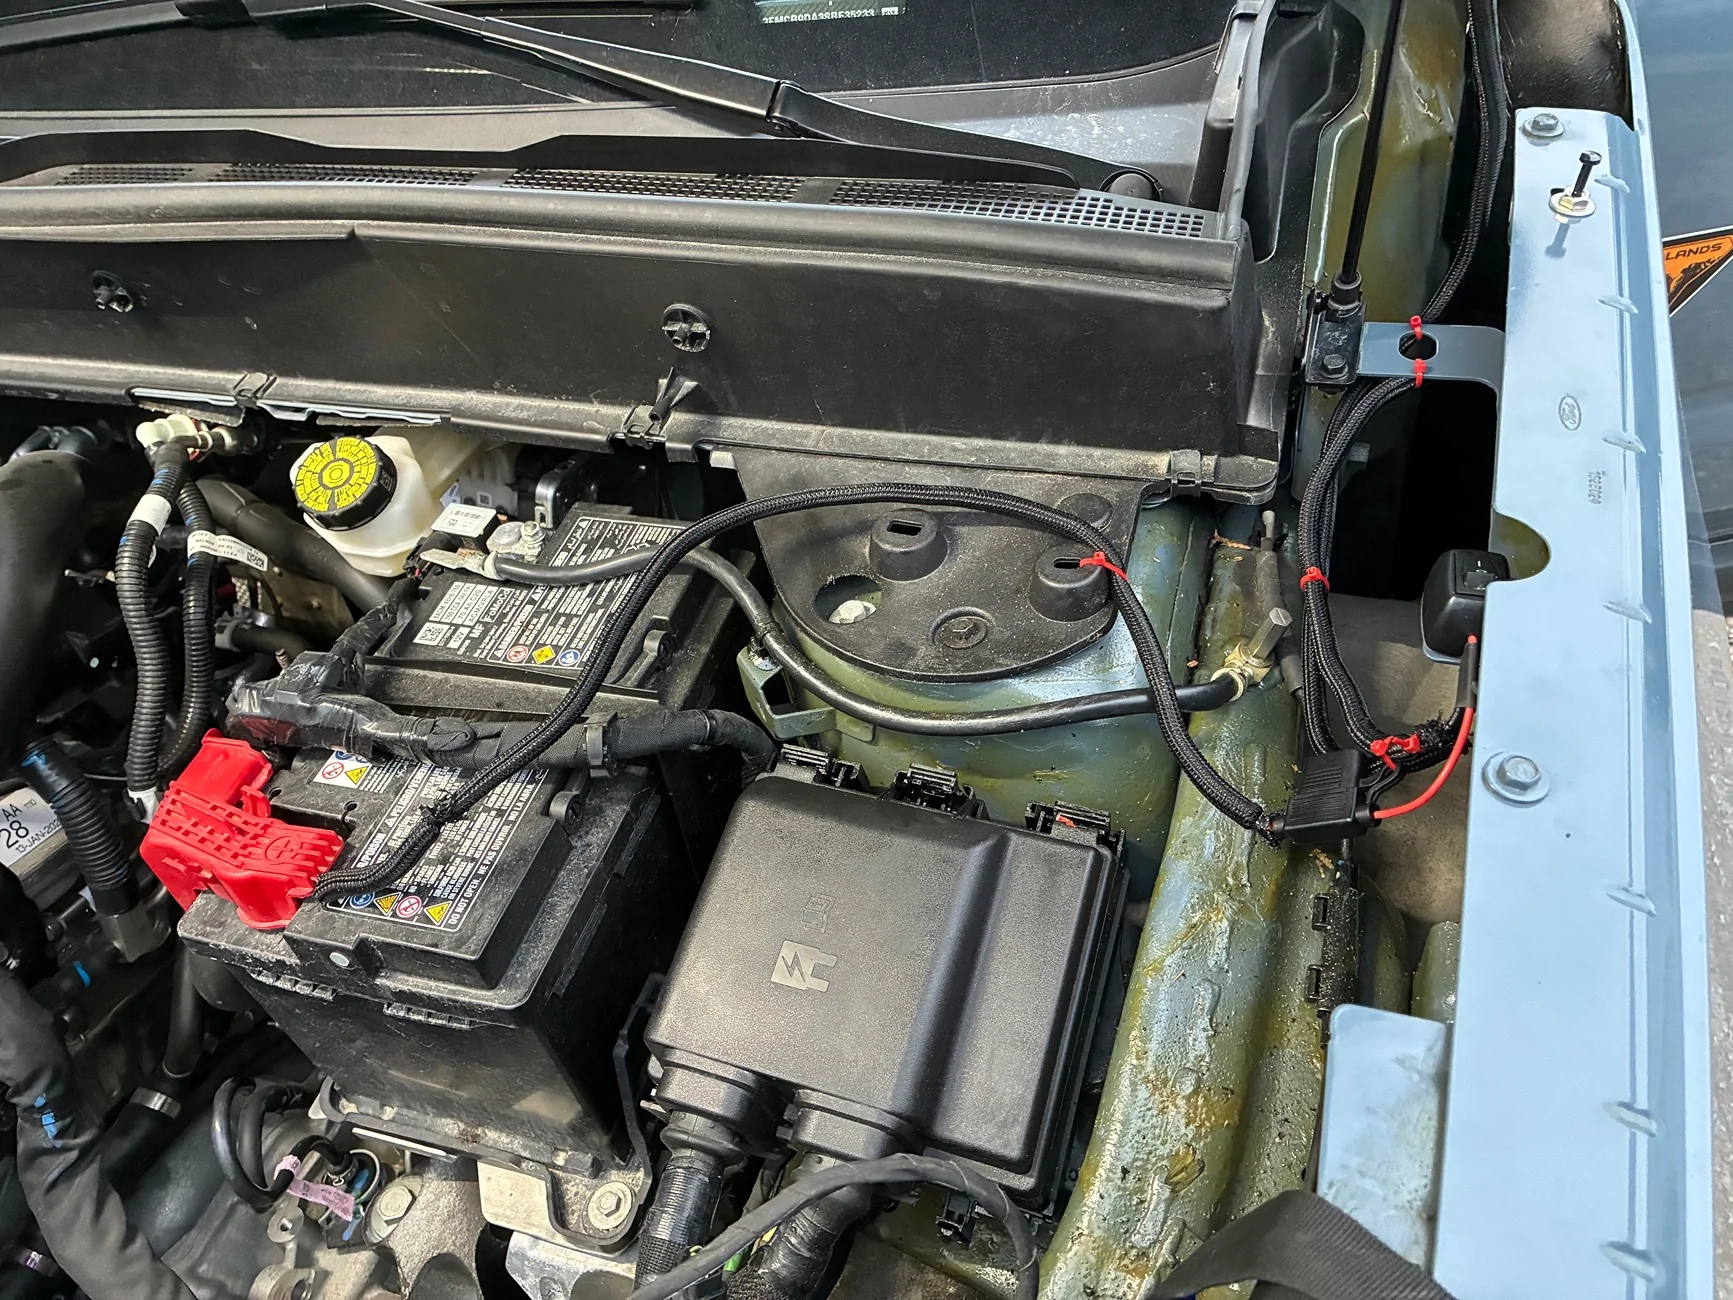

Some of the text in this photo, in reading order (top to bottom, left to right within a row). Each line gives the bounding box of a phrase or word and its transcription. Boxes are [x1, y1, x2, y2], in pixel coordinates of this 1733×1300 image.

[1665, 243, 1723, 260] LANDS
[483, 588, 511, 620] FoMoCo
[452, 631, 465, 643] 12V
[518, 782, 536, 801] ABRA.
[2, 803, 23, 822] AA
[513, 801, 524, 810] LA
[507, 810, 519, 820] NO
[0, 820, 29, 849] 28
[490, 822, 513, 850] OUVRIR.
[482, 850, 497, 865] PAS
[476, 864, 489, 874] NE
[462, 876, 482, 898] OPEN.
[454, 897, 470, 913] NOT
[447, 912, 461, 925] DO
